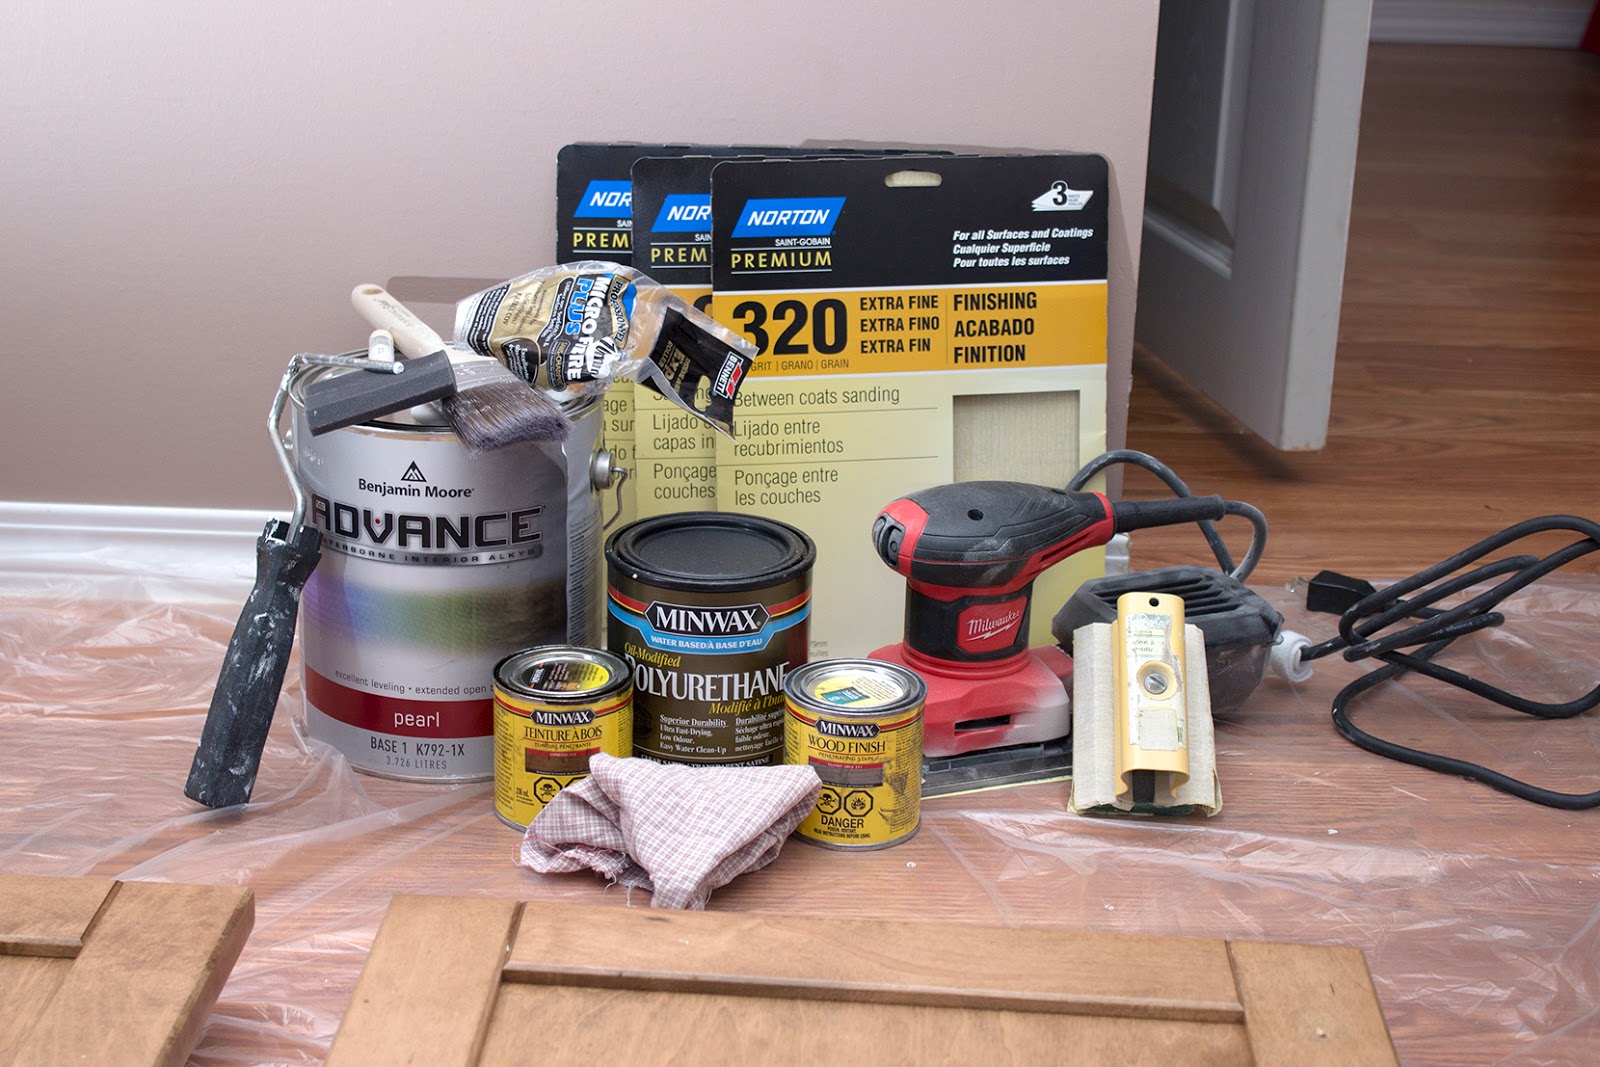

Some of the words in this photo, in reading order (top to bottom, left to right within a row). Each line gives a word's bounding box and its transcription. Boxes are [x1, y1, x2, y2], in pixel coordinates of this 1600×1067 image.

[590, 192, 632, 206] NOR
[1052, 182, 1068, 206] 3
[667, 206, 711, 220] NOR
[747, 209, 830, 226] NORTON
[573, 232, 628, 248] PREM
[775, 238, 830, 246] SAINT-GOBAIN
[953, 230, 970, 240] For
[972, 230, 985, 240] all
[986, 229, 1030, 240] Surfaces
[1031, 228, 1050, 238] and
[1052, 228, 1094, 239] Coatings
[651, 248, 707, 262] PREM
[953, 244, 1000, 256] Cualquier
[1002, 242, 1051, 254] Superficie
[731, 251, 832, 268] PREMIUM
[953, 258, 976, 268] Pour
[978, 258, 1010, 267] toutes
[1012, 256, 1026, 266] les
[1028, 256, 1070, 266] surfaces
[565, 278, 594, 336] PLUS
[582, 277, 612, 334] MICRO
[860, 296, 904, 310] EXTRA
[909, 295, 938, 310] FINE
[954, 292, 1037, 311] FINISHING
[733, 298, 848, 356] 320
[860, 318, 904, 332] EXTRA
[909, 316, 940, 331] FINO
[954, 318, 1034, 338] ACABADO
[860, 340, 904, 354] EXTRA
[910, 338, 930, 352] FIN
[954, 344, 1026, 363] FINITION
[717, 356, 738, 393] BENNETT
[751, 361, 772, 372] GRIT
[782, 360, 814, 370] GRANO
[821, 360, 850, 369] GRAIN
[734, 392, 794, 408] Between
[800, 389, 838, 405] coats
[842, 386, 900, 404] sanding
[653, 414, 698, 433] Lijado
[734, 420, 779, 439] Lijado
[784, 419, 820, 434] entre
[654, 436, 696, 452] capas
[734, 439, 844, 456] recubrimientos
[654, 464, 716, 481] Ponçage
[735, 470, 798, 488] Ponçage
[802, 468, 838, 483] entre
[359, 478, 420, 496] Benjamin
[425, 486, 472, 498] Moore
[654, 484, 715, 499] couches
[736, 490, 756, 506] les
[760, 488, 821, 505] couches
[311, 493, 541, 549] ADVANCE
[324, 538, 395, 560] TERBORNE
[489, 549, 534, 560] ALKYD
[656, 606, 758, 632] MINWAX
[966, 610, 1020, 635] Milwaukee
[651, 636, 677, 646] WATER
[716, 640, 738, 649] BASE
[740, 638, 762, 648] D'EAU
[624, 642, 682, 668] Oil-Modified
[335, 670, 368, 686] excellent
[372, 679, 405, 694] leveling
[416, 684, 460, 695] extended
[464, 685, 487, 696] open
[709, 700, 751, 716] Modifié
[754, 698, 760, 710] à
[394, 712, 440, 728] pearl
[536, 711, 590, 724] MINWAX
[660, 714, 690, 726] Superior
[524, 726, 570, 741] TEINTURE
[571, 727, 579, 740] À
[581, 725, 603, 740] BOIS
[660, 724, 674, 733] Ultra
[660, 732, 672, 740] Low
[820, 721, 874, 736] MINWAX
[371, 736, 398, 754] BASE
[402, 742, 407, 754] 1
[416, 744, 465, 756] K792-1X
[660, 742, 673, 752] Easy
[676, 743, 694, 752] Water
[696, 745, 726, 754] Clean-Up
[808, 734, 846, 752] WOOD
[849, 741, 886, 753] FINISH
[386, 756, 410, 768] 3.726
[415, 760, 447, 770] LITRES
[819, 752, 856, 761] PENETRATING
[821, 815, 864, 828] DANGER
